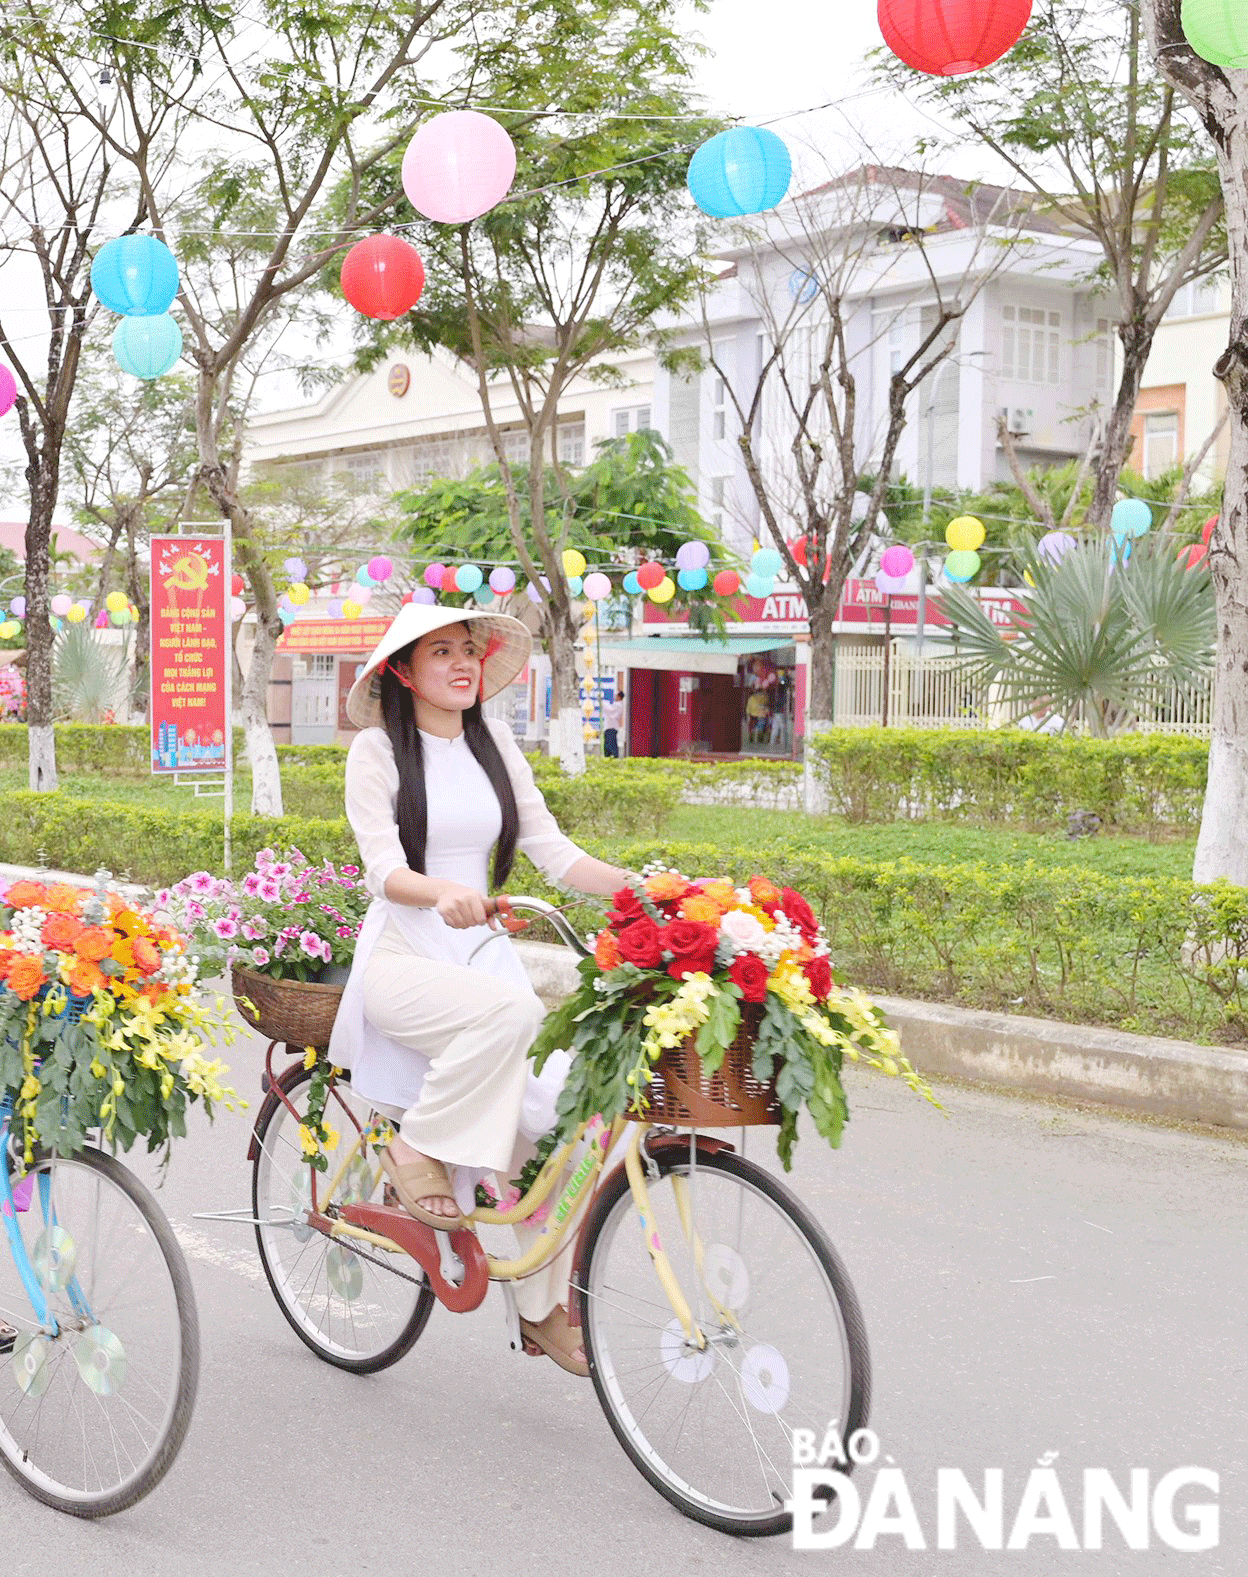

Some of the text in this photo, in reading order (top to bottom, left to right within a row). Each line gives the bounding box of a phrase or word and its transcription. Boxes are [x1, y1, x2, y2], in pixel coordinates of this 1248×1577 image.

[855, 587, 883, 603] ATM
[181, 606, 200, 619] CỘNG
[201, 605, 216, 618] SẢN
[761, 596, 810, 619] ATM
[980, 600, 1011, 623] TM
[170, 622, 185, 634] VIỆT
[185, 623, 202, 633] NAM
[182, 636, 200, 648] LÃNH
[184, 651, 203, 663] CHỨC
[163, 667, 178, 679] MỌI
[202, 667, 214, 679] LỢI
[160, 679, 217, 695] CỦA CÁCH MẠNG
[171, 696, 186, 709] VIỆT
